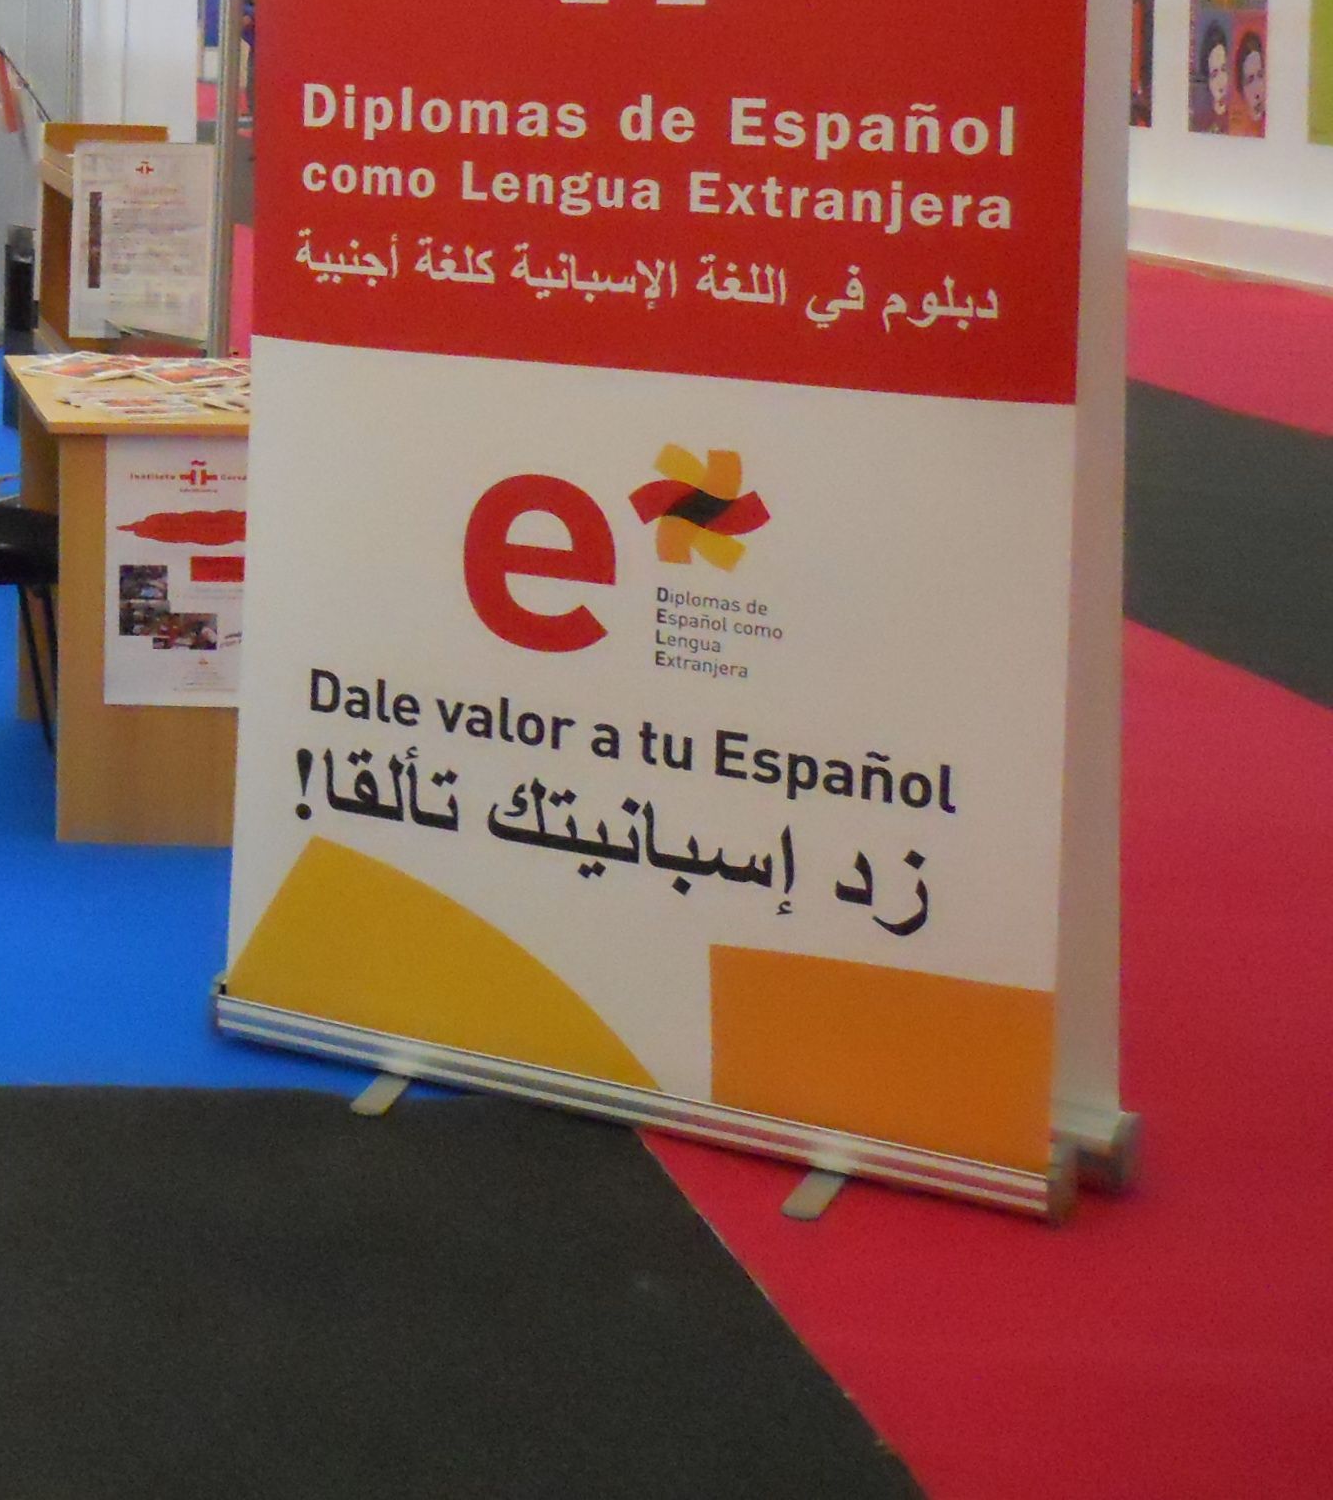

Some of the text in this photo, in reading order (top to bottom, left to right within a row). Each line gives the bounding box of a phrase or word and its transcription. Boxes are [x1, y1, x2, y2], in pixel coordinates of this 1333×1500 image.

[301, 83, 1016, 160] Diplomas de Español
[301, 161, 1012, 234] como Lengua Extranjera
[294, 229, 1000, 332] دبلوم في اللغة الإسبانية كلغة أجنبية
[656, 608, 783, 640] Español como
[657, 586, 768, 616] Diplomas de
[655, 629, 721, 654] Lengua
[655, 651, 748, 679] Extranjera
[309, 668, 957, 814] Dale valor a tu Español
[487, 777, 795, 915] إسبانيتك
[835, 848, 929, 936] زد
